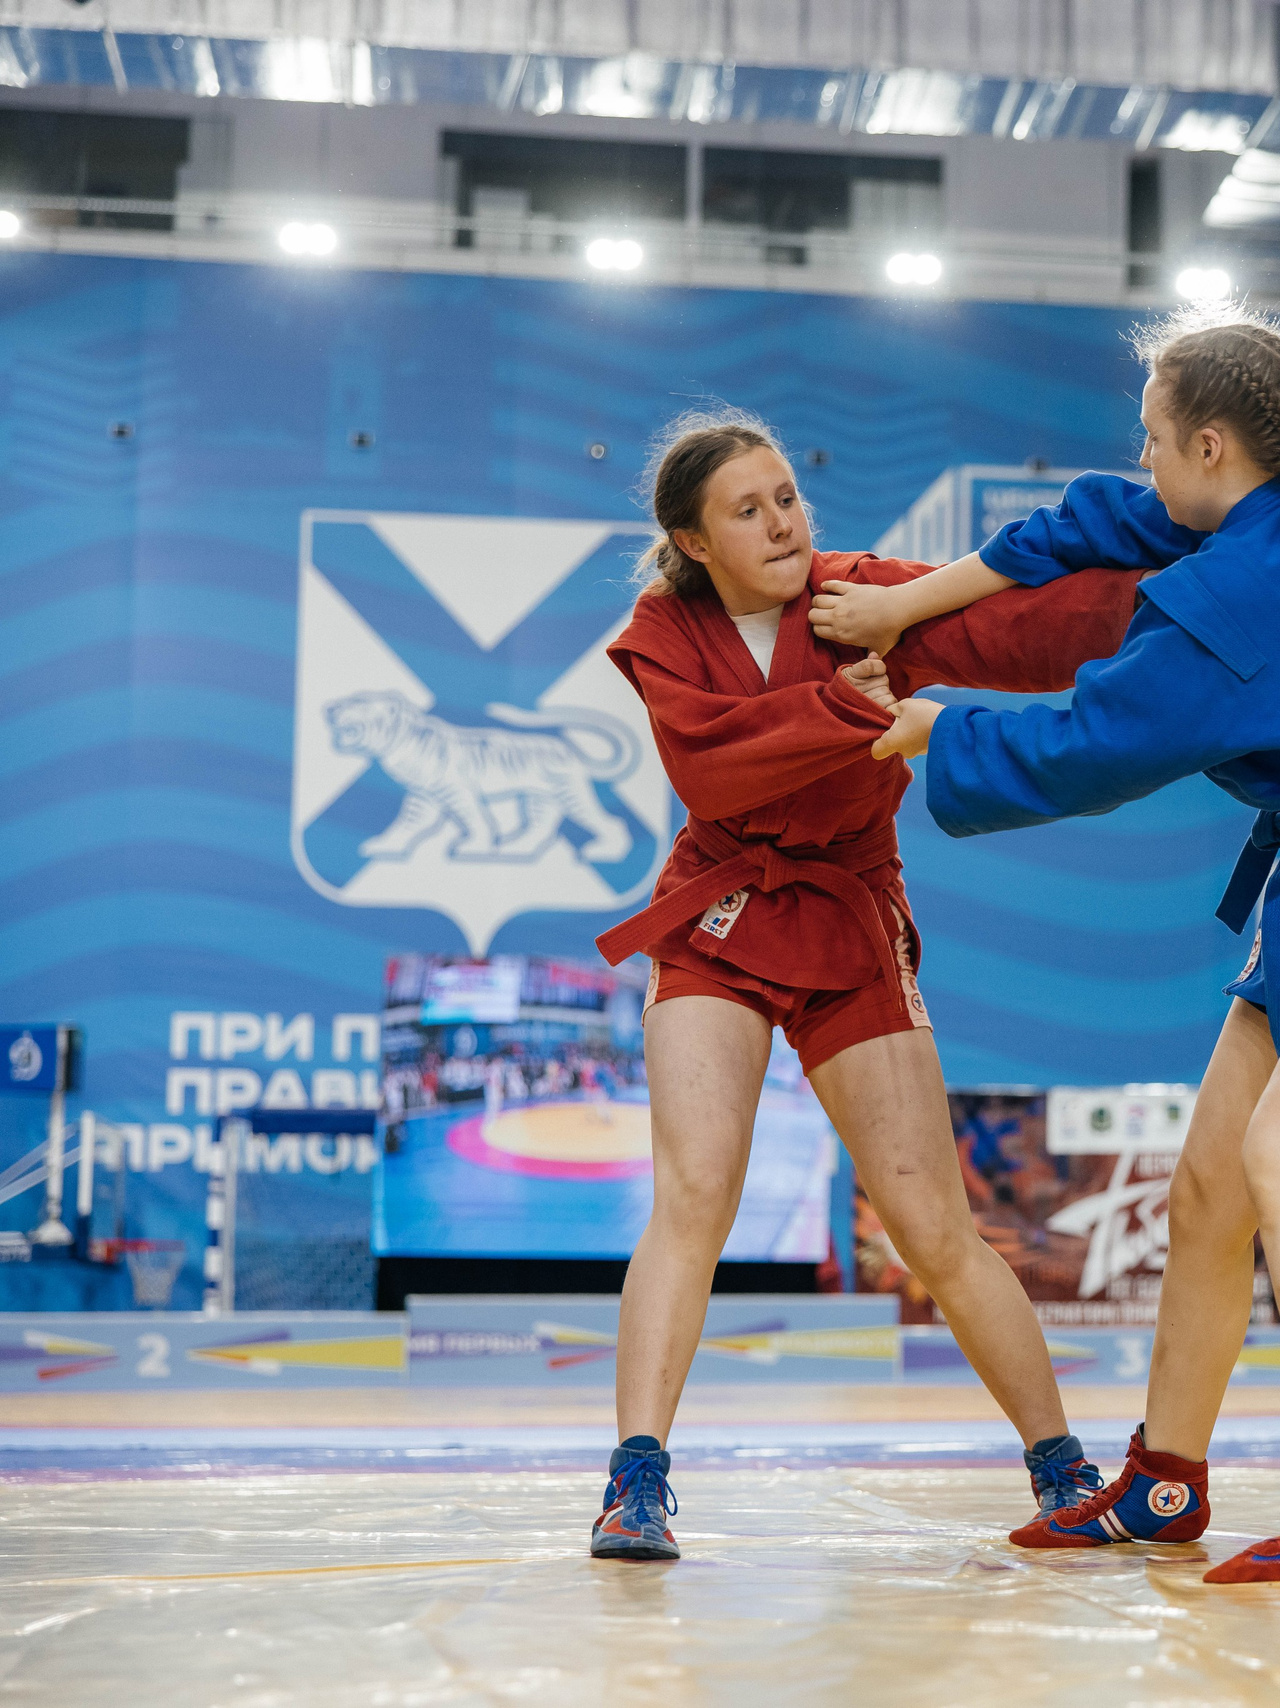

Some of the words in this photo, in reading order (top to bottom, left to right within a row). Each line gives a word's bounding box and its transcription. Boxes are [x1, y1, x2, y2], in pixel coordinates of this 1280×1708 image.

[169, 1010, 313, 1062] ПРИ
[136, 1332, 171, 1378] 2
[1115, 1338, 1148, 1379] 3
